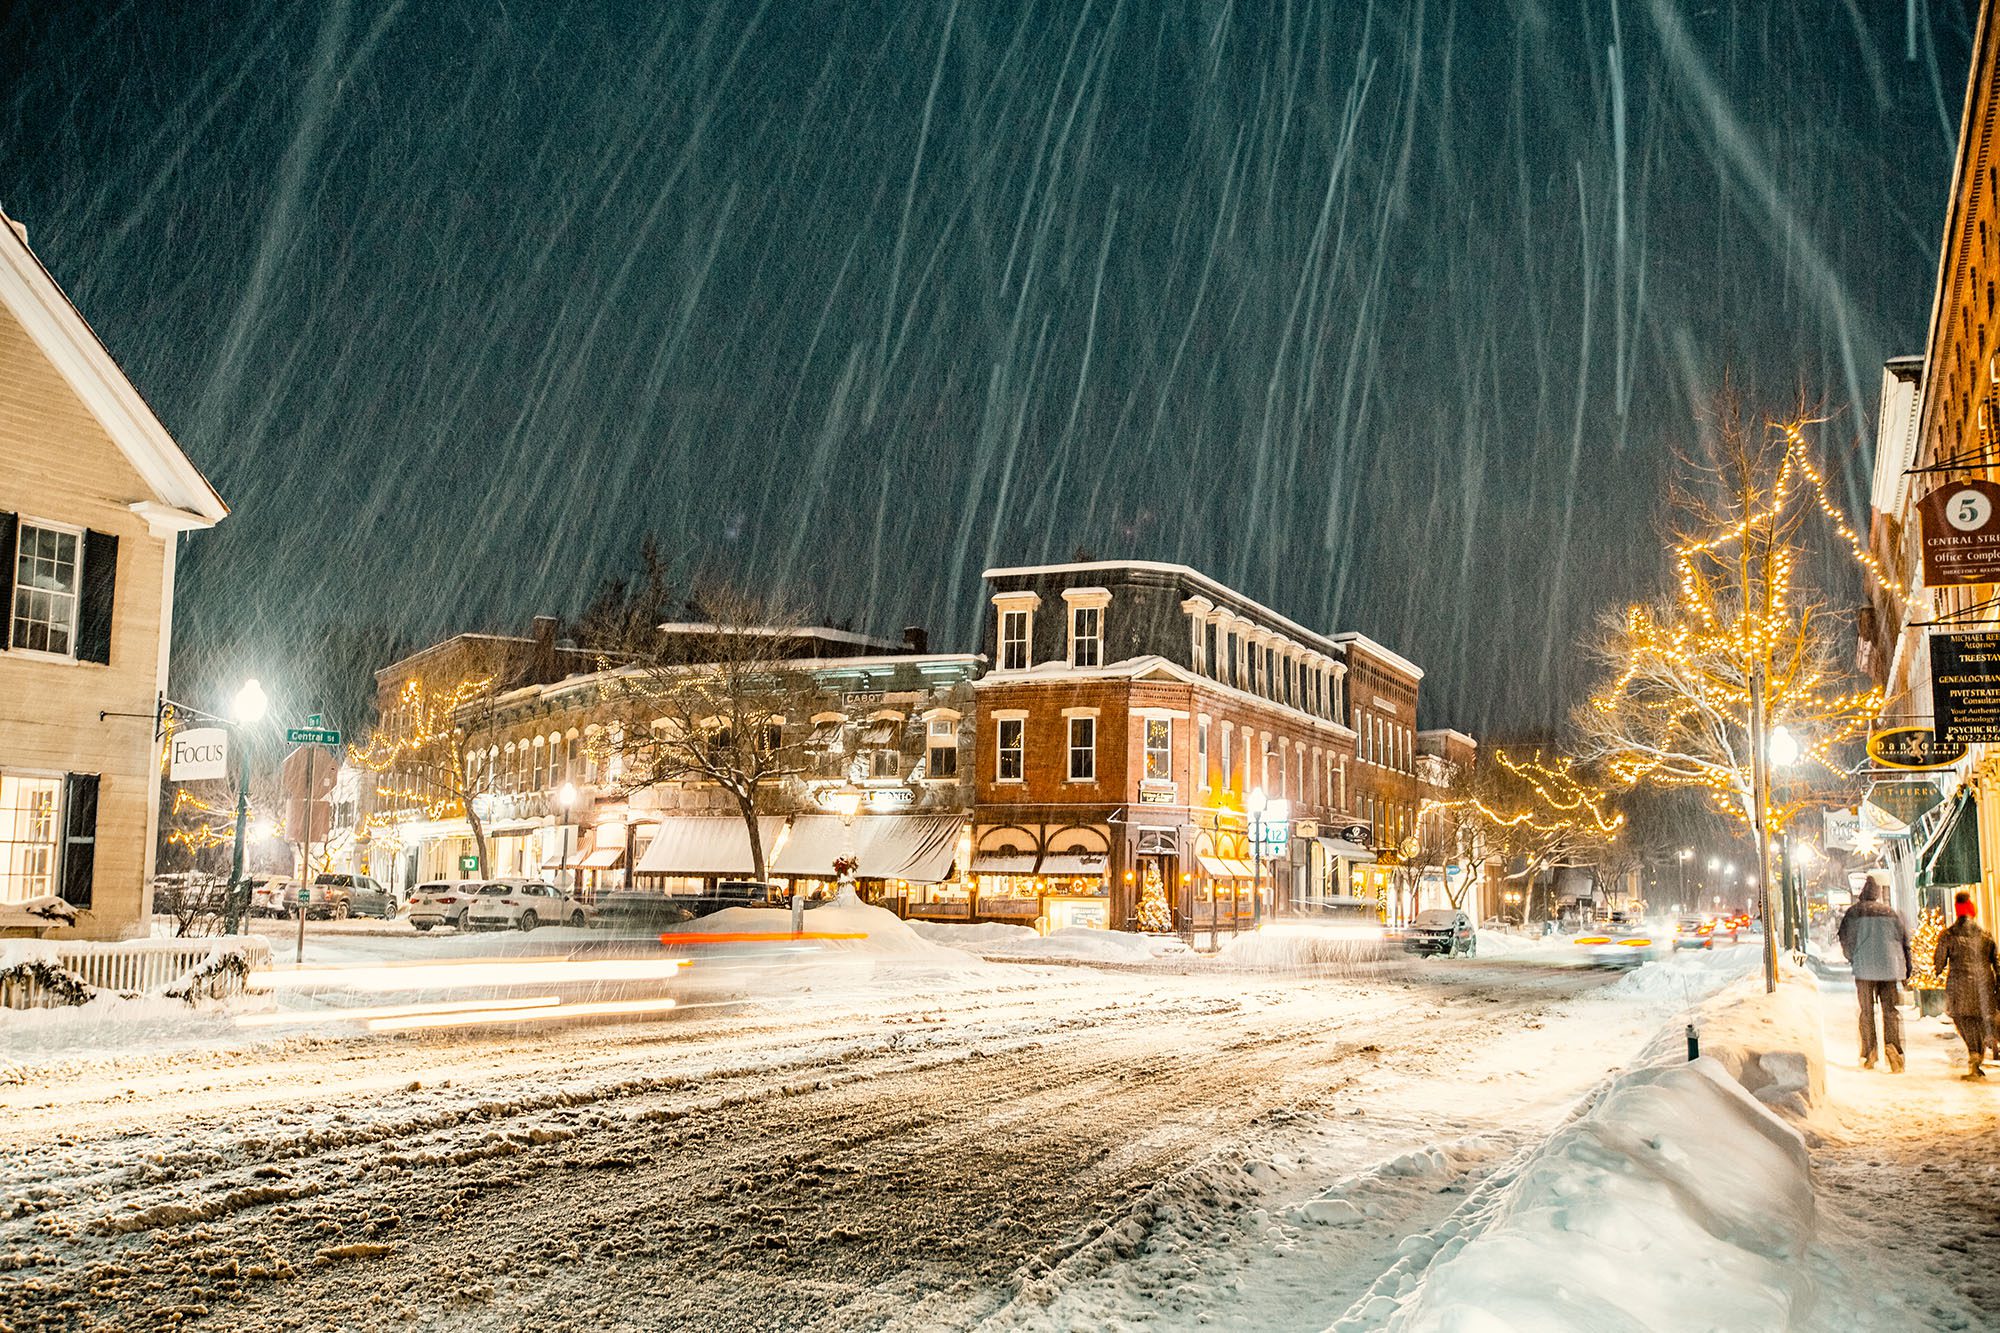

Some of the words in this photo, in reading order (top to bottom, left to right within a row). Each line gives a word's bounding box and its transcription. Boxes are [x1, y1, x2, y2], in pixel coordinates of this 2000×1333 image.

[1959, 499, 1978, 522] 5
[1927, 536, 1973, 546] CENTRAL
[1935, 552, 1962, 562] Office
[1950, 634, 1984, 642] MICHAEL
[1964, 641, 1996, 649] Attorney
[846, 693, 881, 704] CABOT
[1948, 726, 1985, 734] PSYCHIC
[291, 731, 323, 741] Central
[1272, 830, 1282, 840] 12
[463, 858, 476, 869] TD
